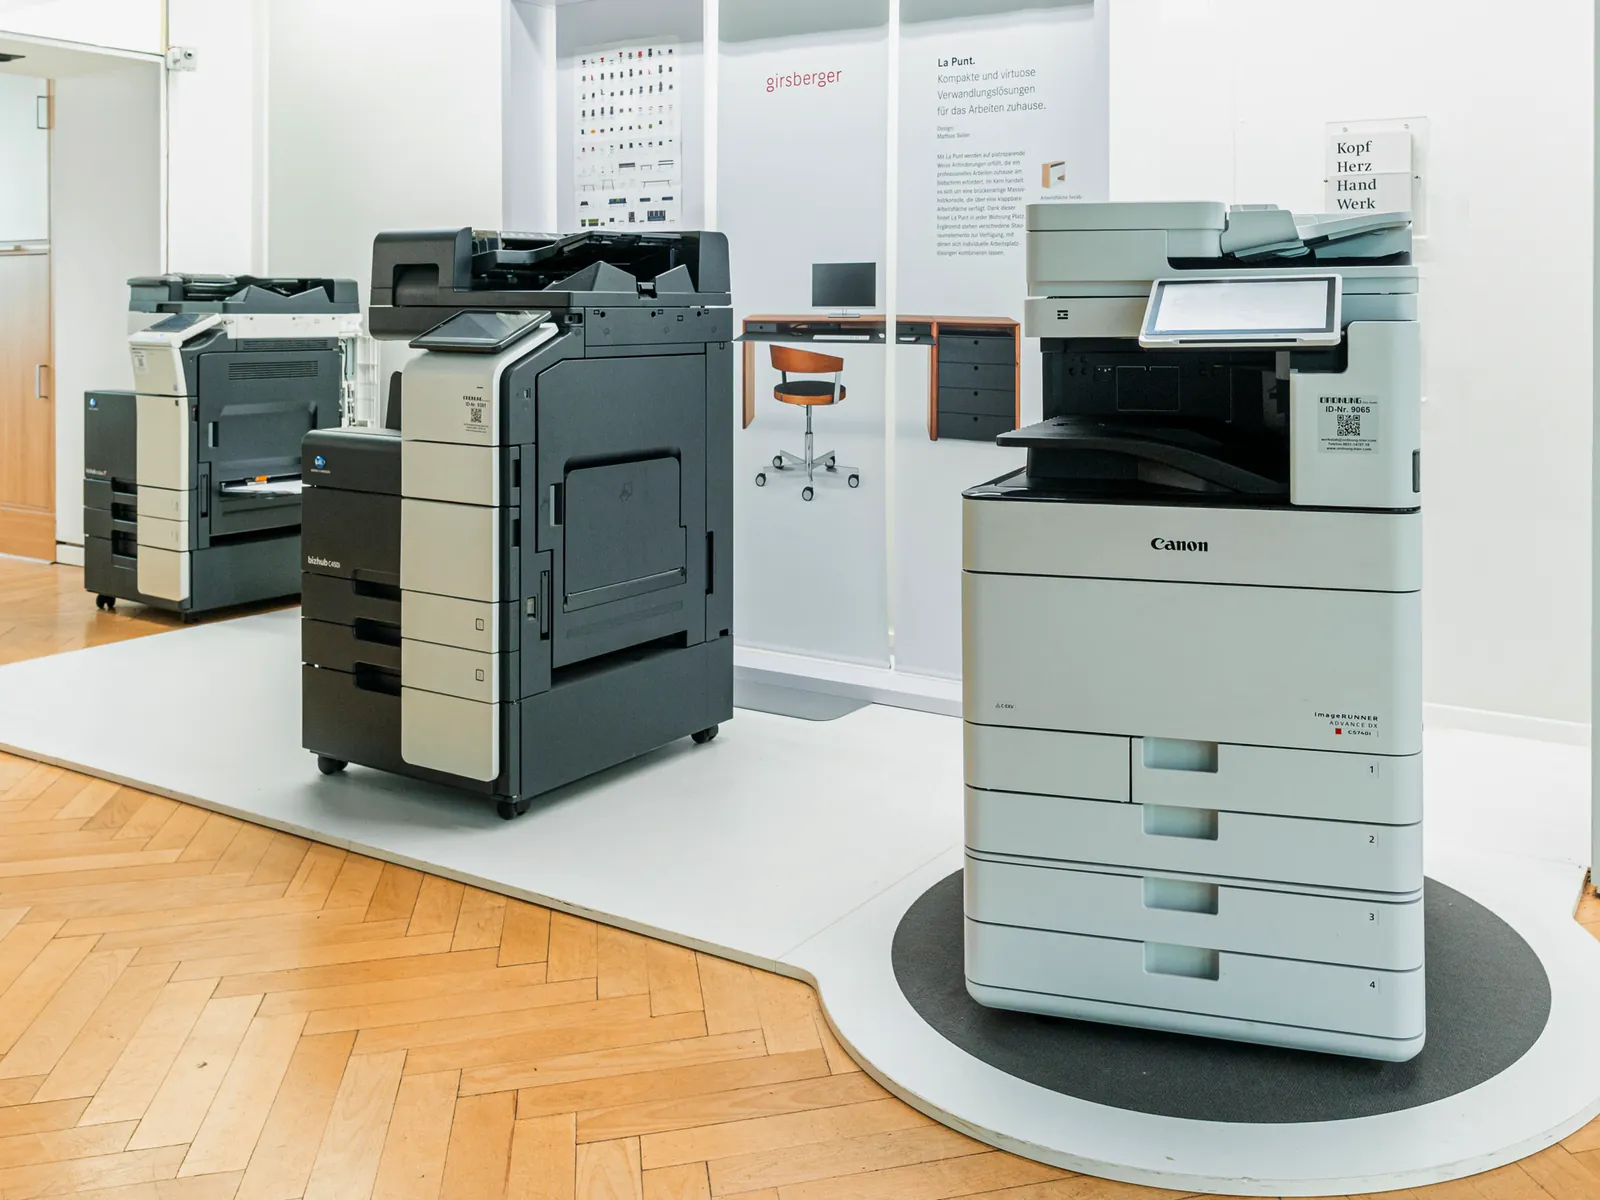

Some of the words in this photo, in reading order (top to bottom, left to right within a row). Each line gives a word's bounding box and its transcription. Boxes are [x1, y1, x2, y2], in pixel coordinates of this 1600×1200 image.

[938, 59, 948, 67] La
[951, 57, 975, 66] Punt.
[766, 71, 842, 92] girsberger
[938, 73, 980, 84] Kompakte
[982, 71, 998, 80] und
[1000, 68, 1036, 79] virtuose
[937, 85, 1035, 100] Verwandlungslösungen
[937, 107, 948, 116] für
[951, 106, 966, 115] das
[969, 104, 1004, 114] Arbeiten
[1007, 102, 1046, 112] zuhause.
[1336, 140, 1372, 156] Kopf
[1336, 161, 1372, 172] Herz
[1336, 178, 1376, 192] Hand
[1336, 198, 1376, 210] Werk
[1150, 538, 1208, 552] Canon
[1314, 712, 1378, 721] imageRUNNER
[1370, 766, 1374, 774] 1
[1369, 836, 1375, 844] 2
[1369, 913, 1375, 921] 3
[1370, 980, 1376, 988] 4
